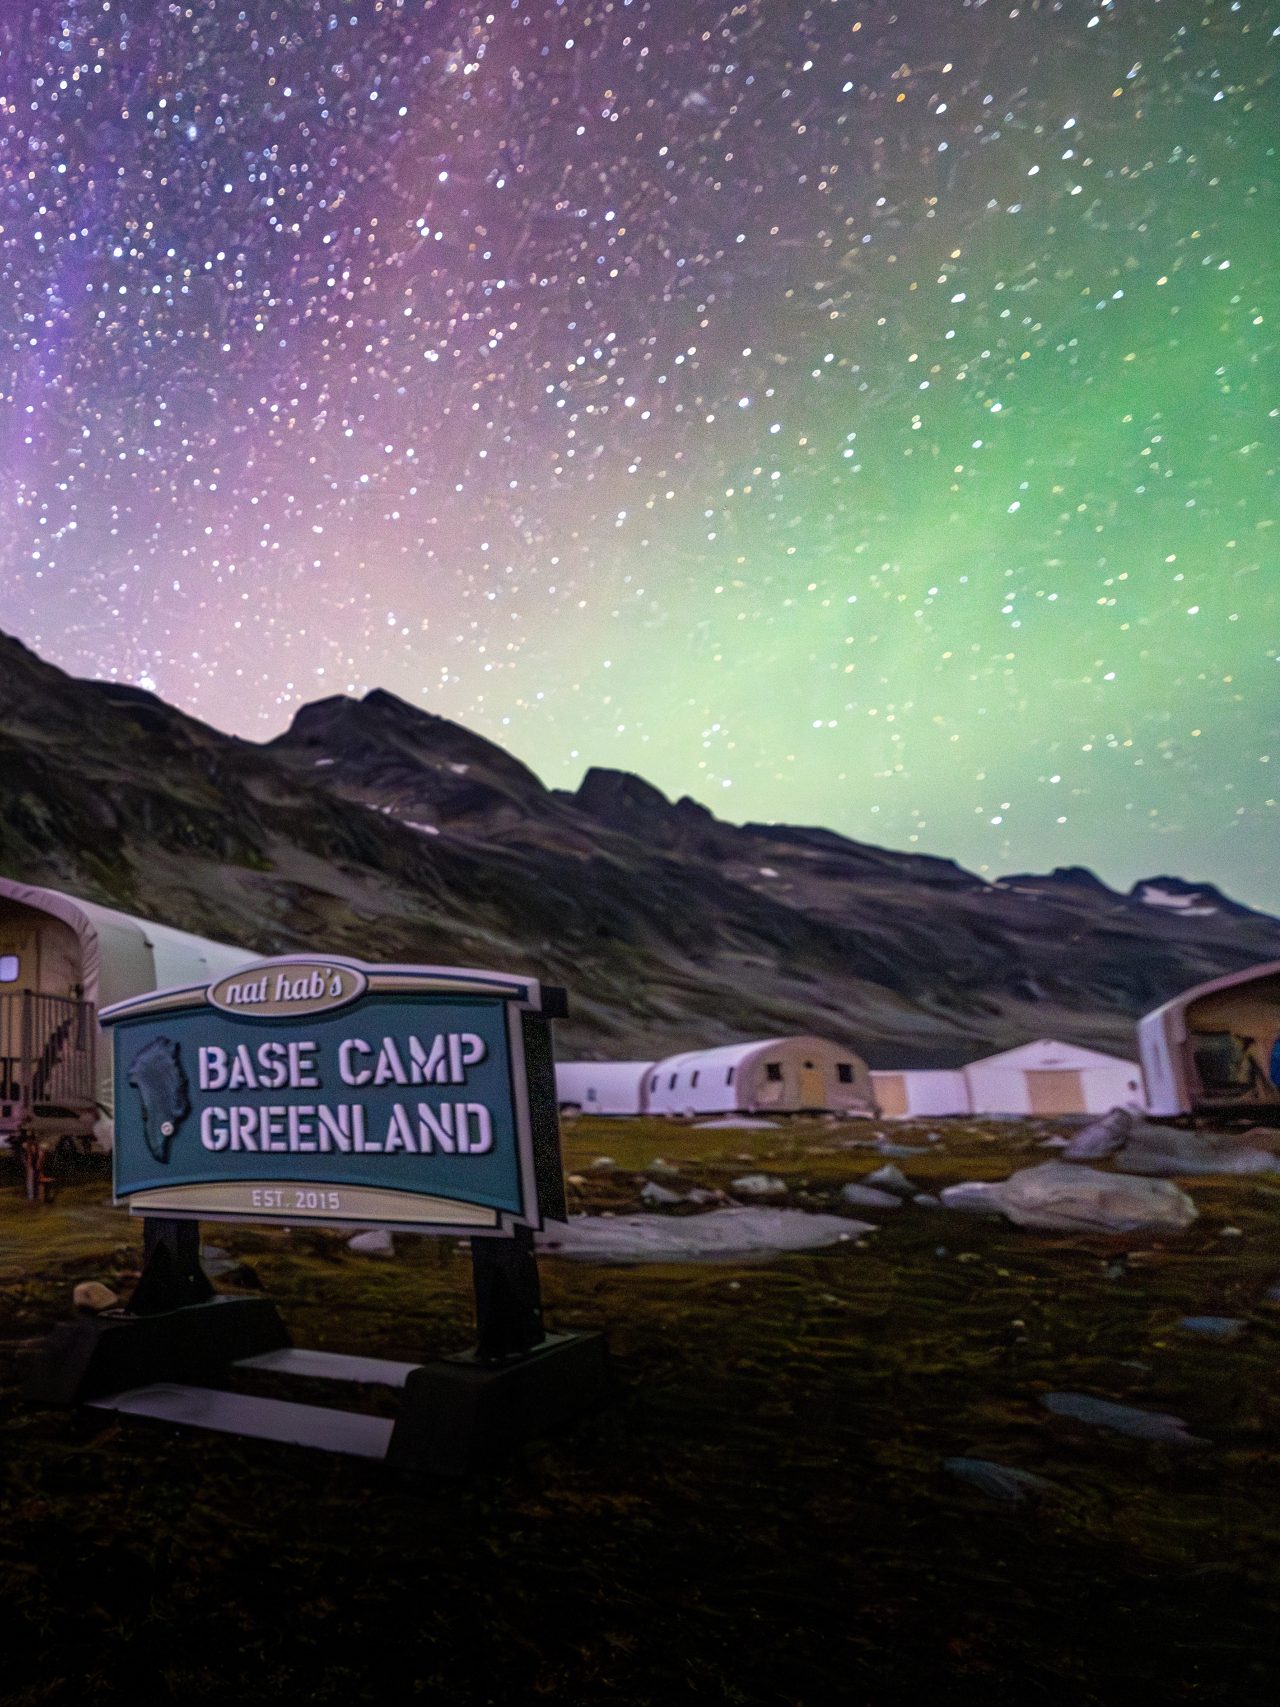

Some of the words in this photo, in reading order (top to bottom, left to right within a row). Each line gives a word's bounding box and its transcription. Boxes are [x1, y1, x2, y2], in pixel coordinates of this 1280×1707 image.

[225, 975, 269, 1004] nat
[275, 968, 343, 1001] hab's
[198, 1041, 319, 1090] BASE
[338, 1033, 487, 1087] CAMP
[200, 1102, 493, 1154] GREENLAND
[252, 1190, 292, 1208] EST.
[295, 1191, 340, 1209] 2015
